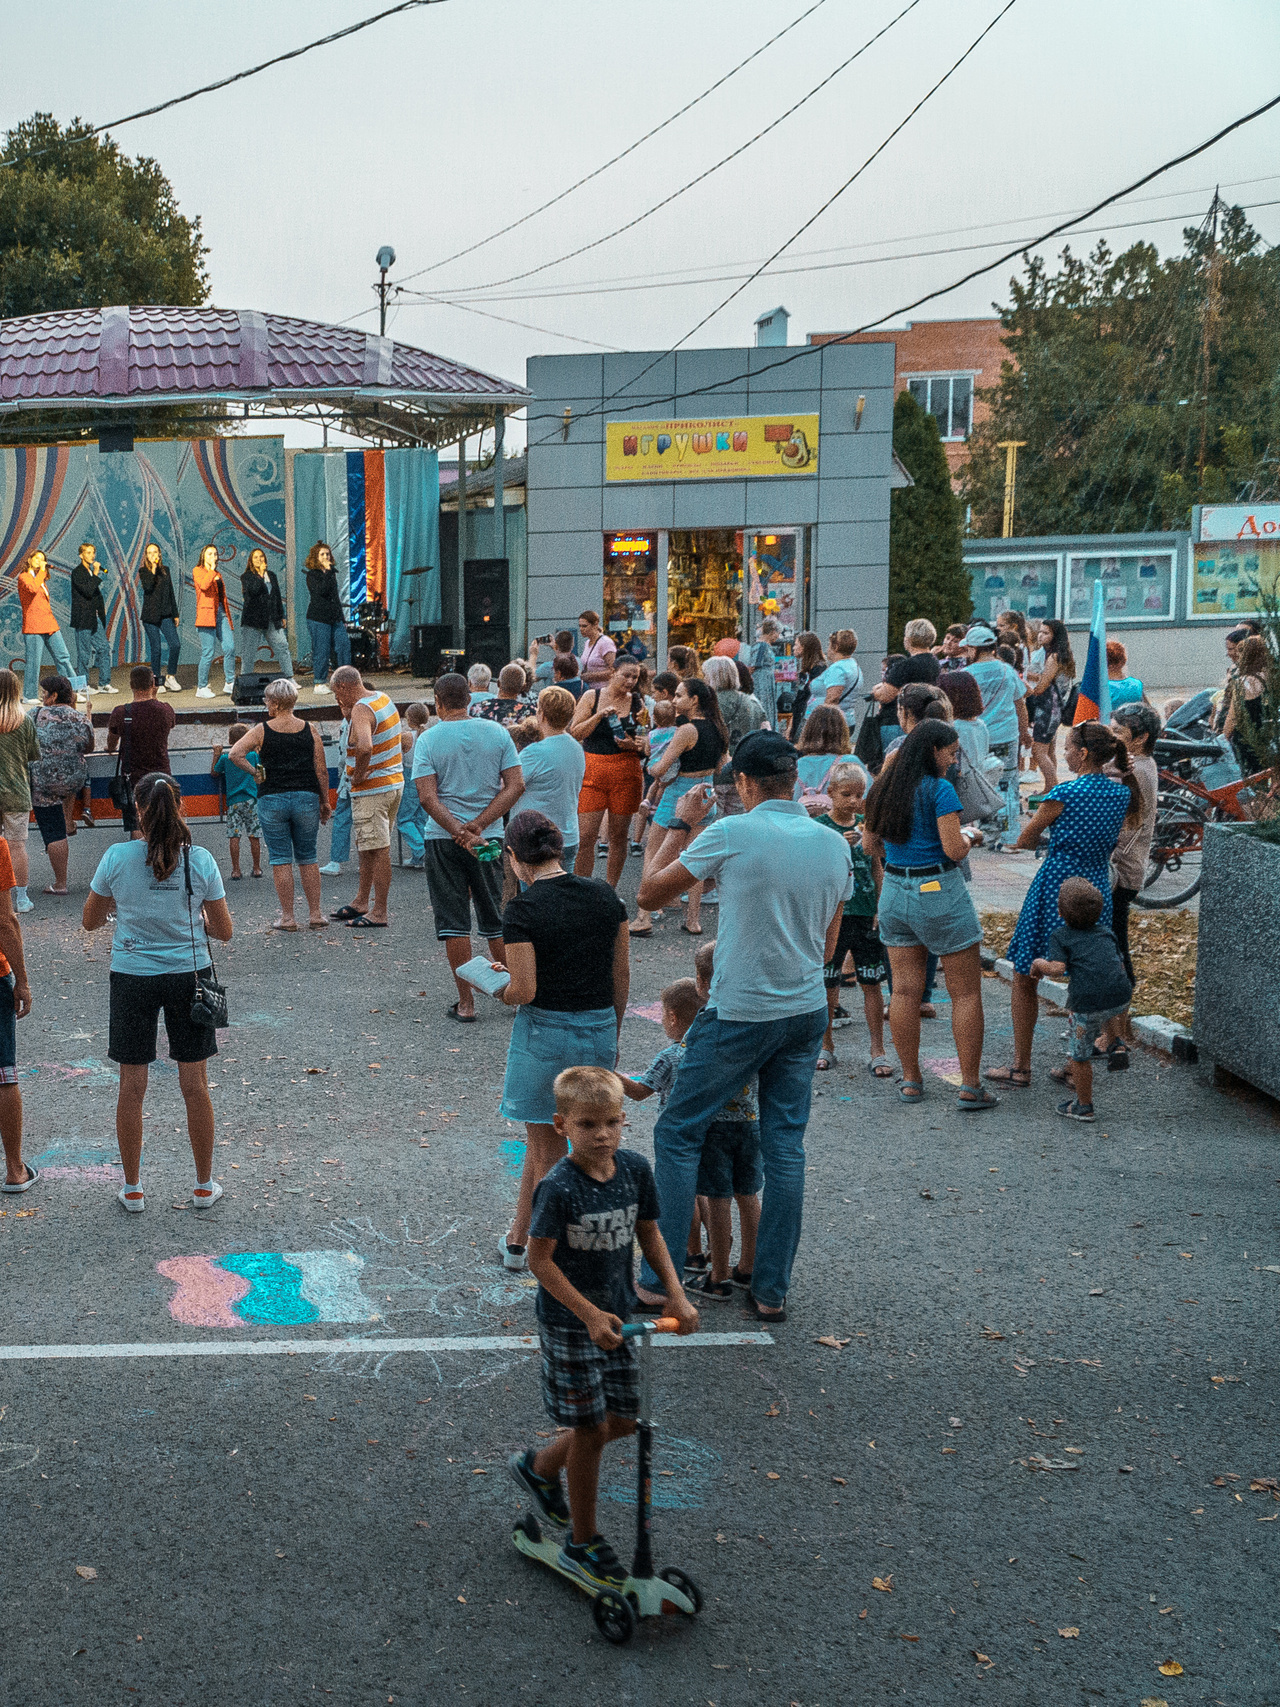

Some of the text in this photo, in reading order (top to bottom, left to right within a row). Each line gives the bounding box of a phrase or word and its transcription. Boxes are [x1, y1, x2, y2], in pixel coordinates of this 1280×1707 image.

[622, 431, 748, 462] ИГРУШКИ
[1236, 514, 1280, 540] До
[567, 1203, 639, 1232] STAR
[567, 1226, 634, 1251] WAR
